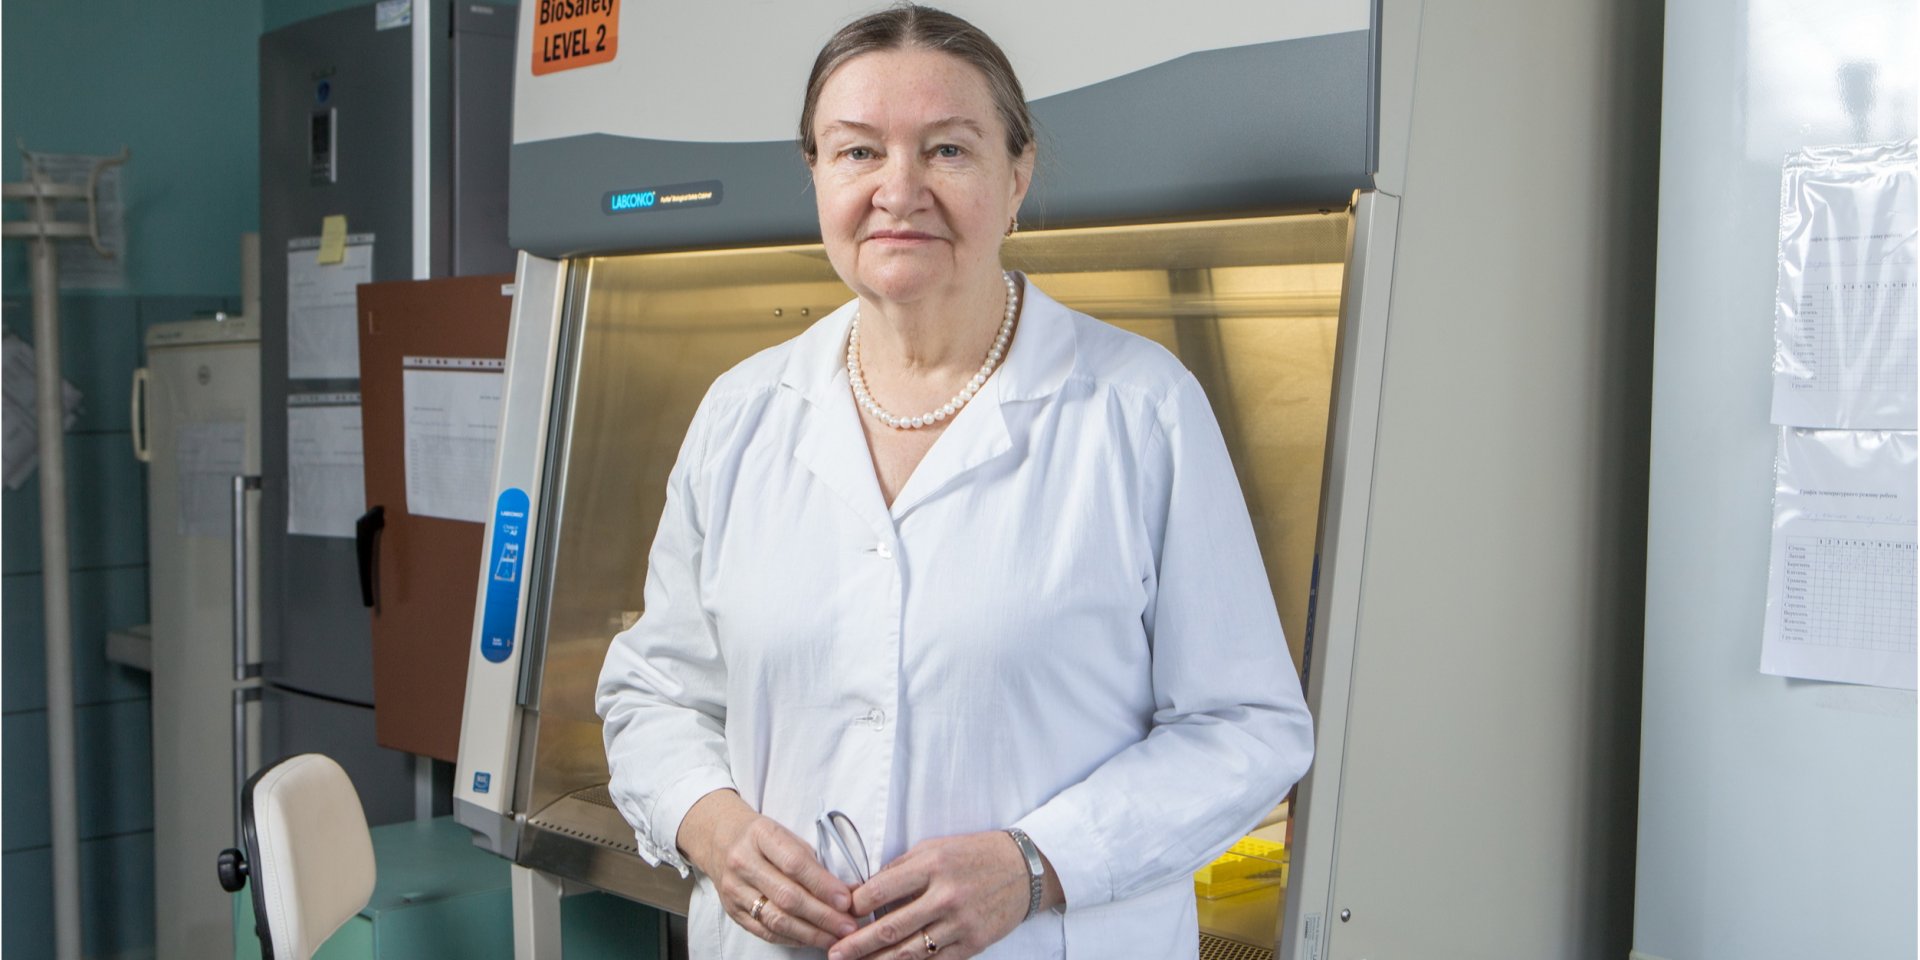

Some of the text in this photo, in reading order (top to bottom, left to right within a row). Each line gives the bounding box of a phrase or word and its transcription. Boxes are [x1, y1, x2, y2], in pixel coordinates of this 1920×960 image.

[543, 23, 606, 63] LEVEL 2
[611, 191, 655, 211] LABCONCO
